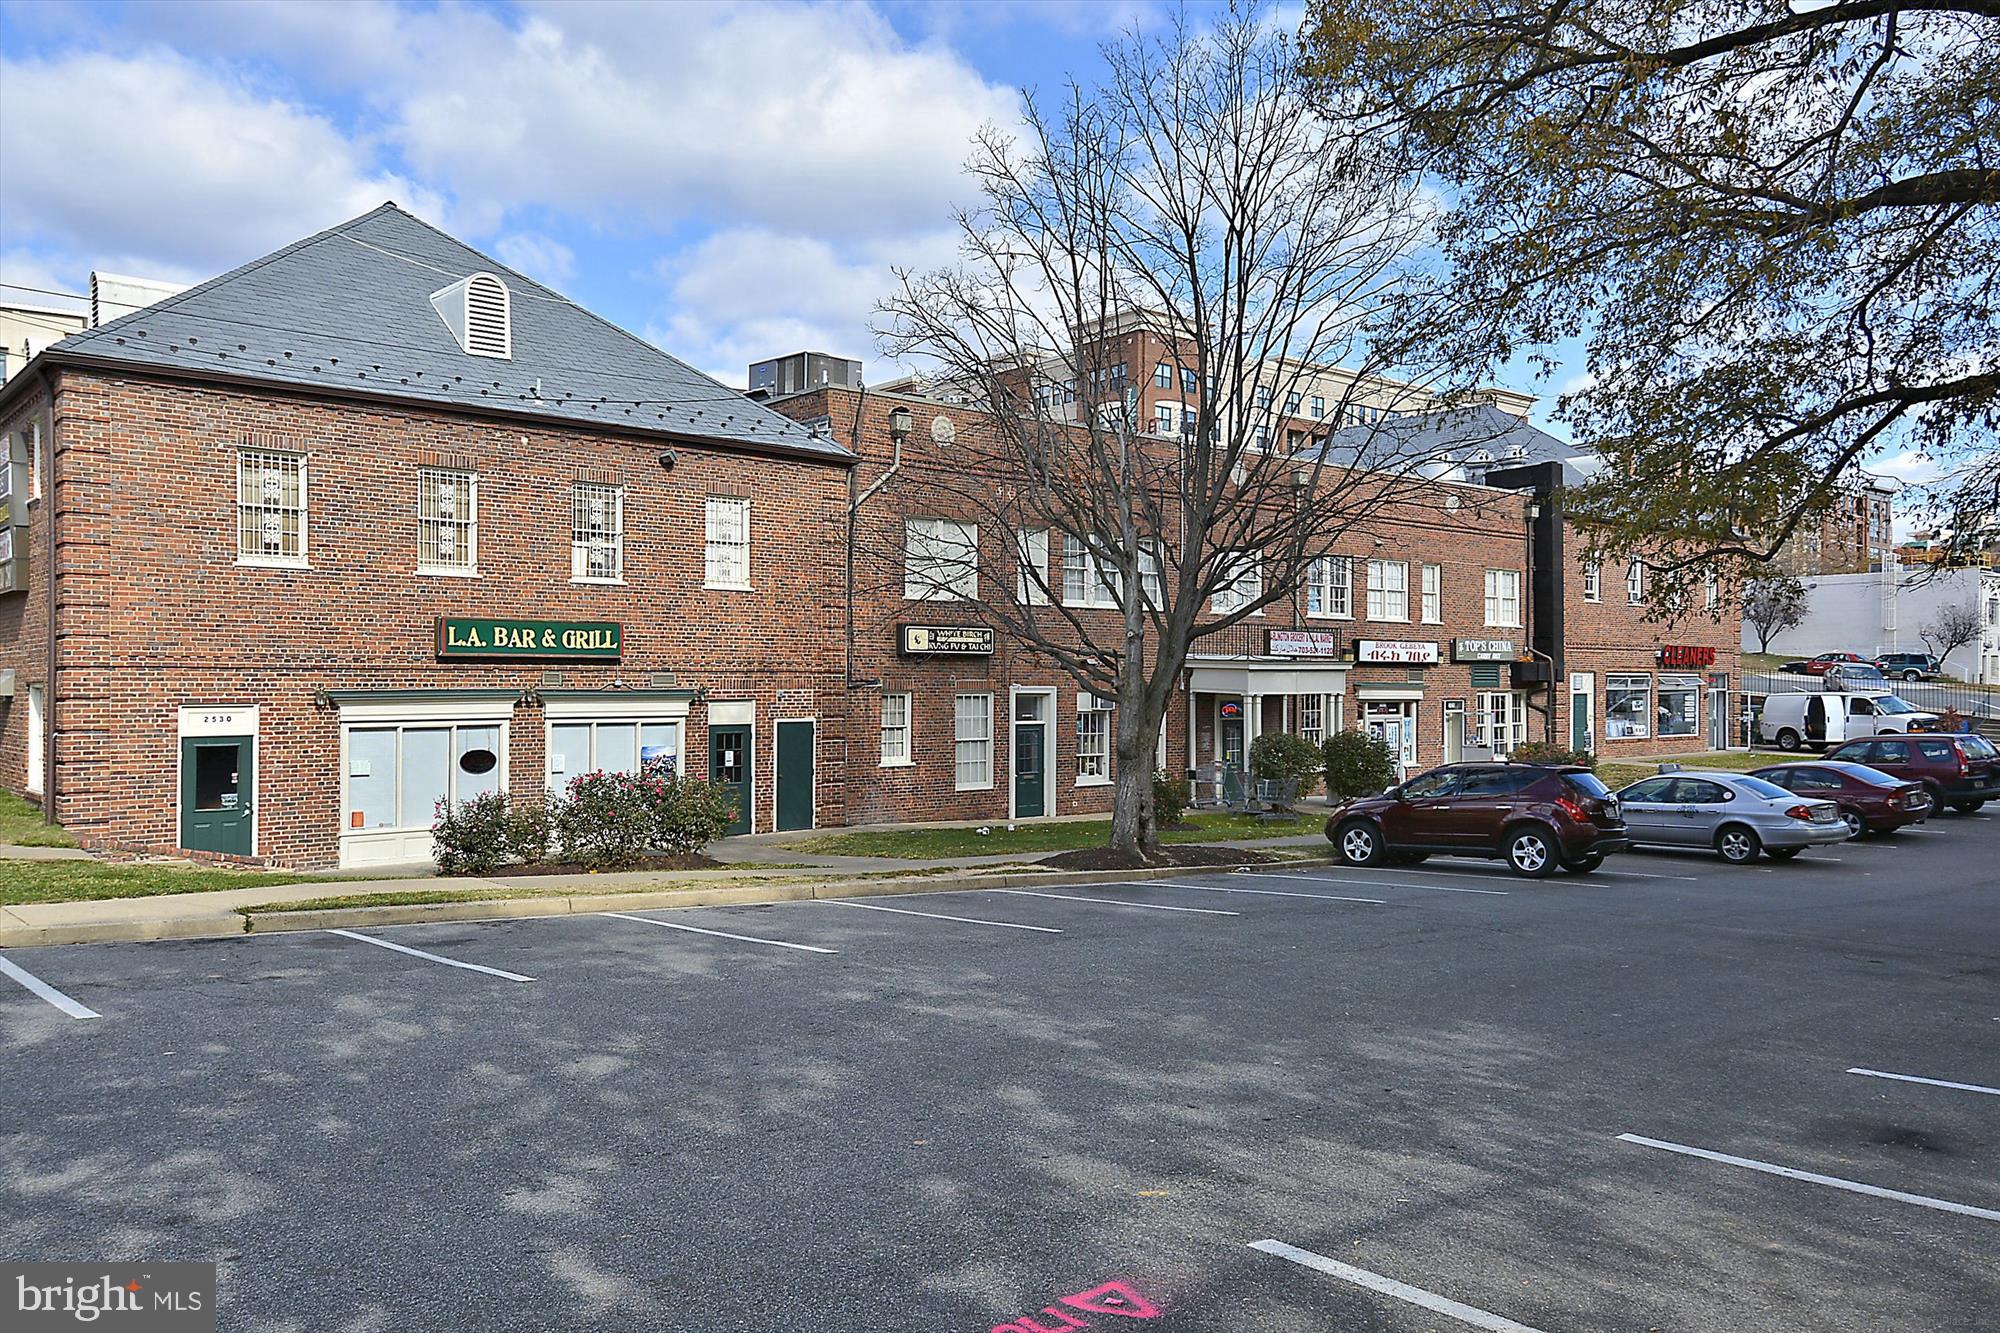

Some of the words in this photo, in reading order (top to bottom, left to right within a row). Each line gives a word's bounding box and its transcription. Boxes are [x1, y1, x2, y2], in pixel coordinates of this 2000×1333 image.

[448, 627, 487, 647] L.A.
[493, 627, 537, 648] BAR
[541, 629, 557, 648] &
[562, 630, 618, 649] GRILL
[962, 630, 983, 638] BIRCH
[929, 642, 949, 650] KUNG
[979, 643, 992, 651] CHI
[1465, 640, 1487, 652] TOP'S
[1488, 640, 1513, 652] CHINA
[1664, 645, 1716, 665] CLEANERS
[203, 715, 232, 723] 2530
